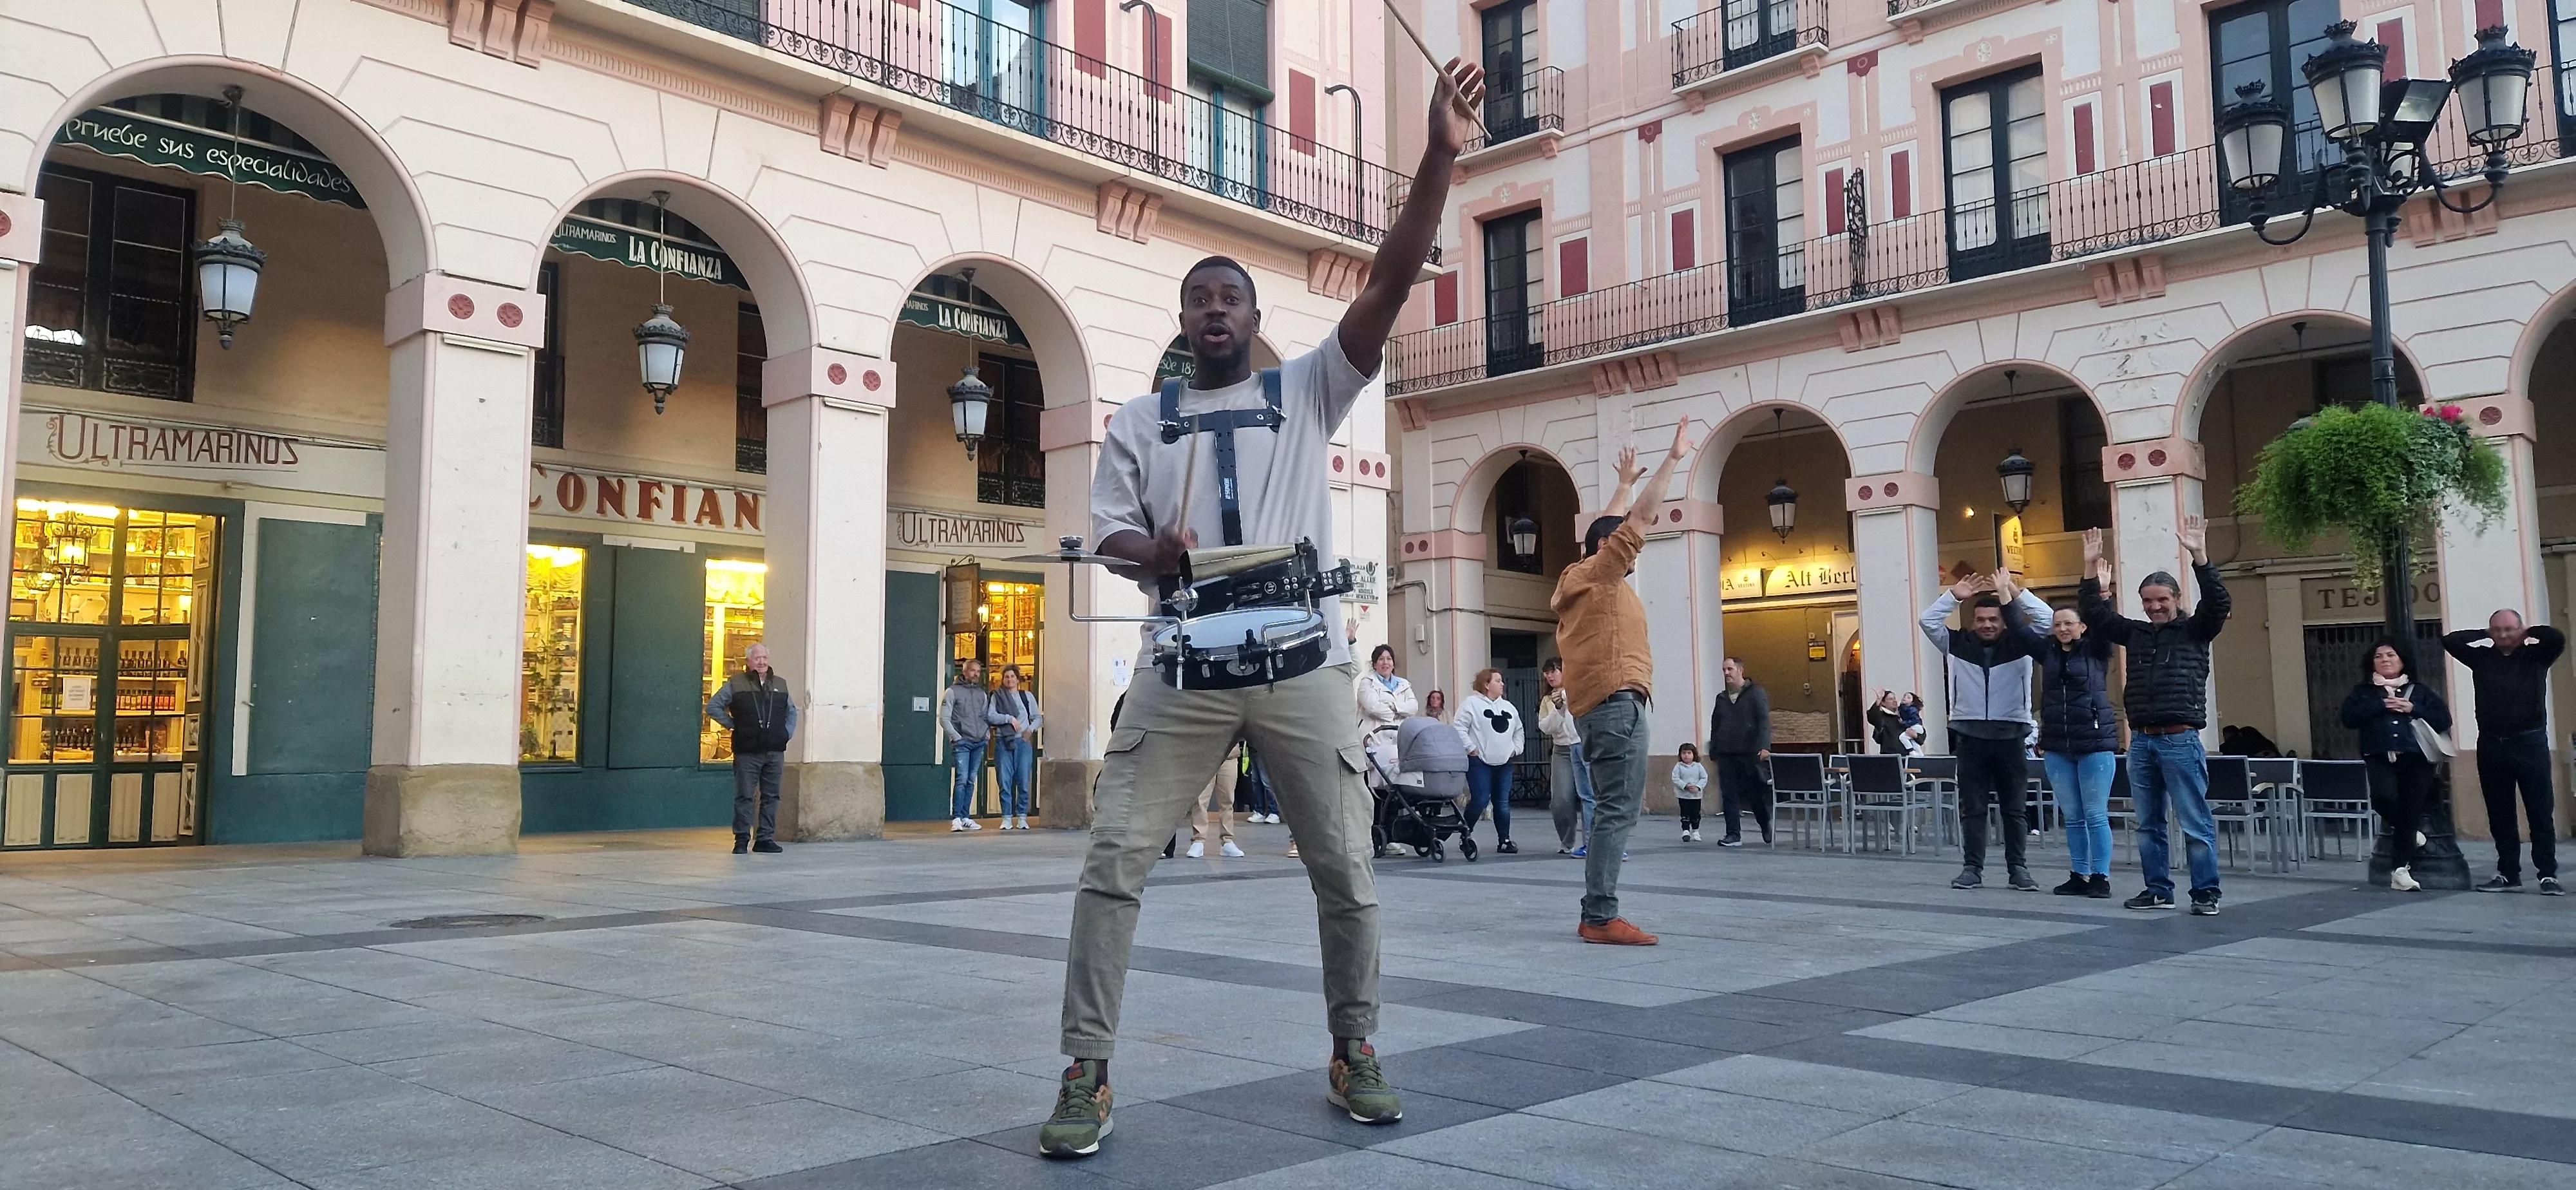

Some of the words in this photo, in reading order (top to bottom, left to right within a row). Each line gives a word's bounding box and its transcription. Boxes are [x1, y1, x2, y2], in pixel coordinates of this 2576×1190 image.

[65, 118, 147, 149] pruebe
[157, 137, 194, 159] sus
[206, 148, 350, 193] especialidades
[629, 236, 645, 263] LA
[650, 239, 722, 280] CONFIANZA
[938, 304, 951, 327] LA
[954, 308, 1008, 339] CONFIANZA
[57, 414, 299, 466] ULTRAMARINOS
[902, 512, 1025, 543] ULTRAMARINOS
[1785, 570, 1812, 589] Alt
